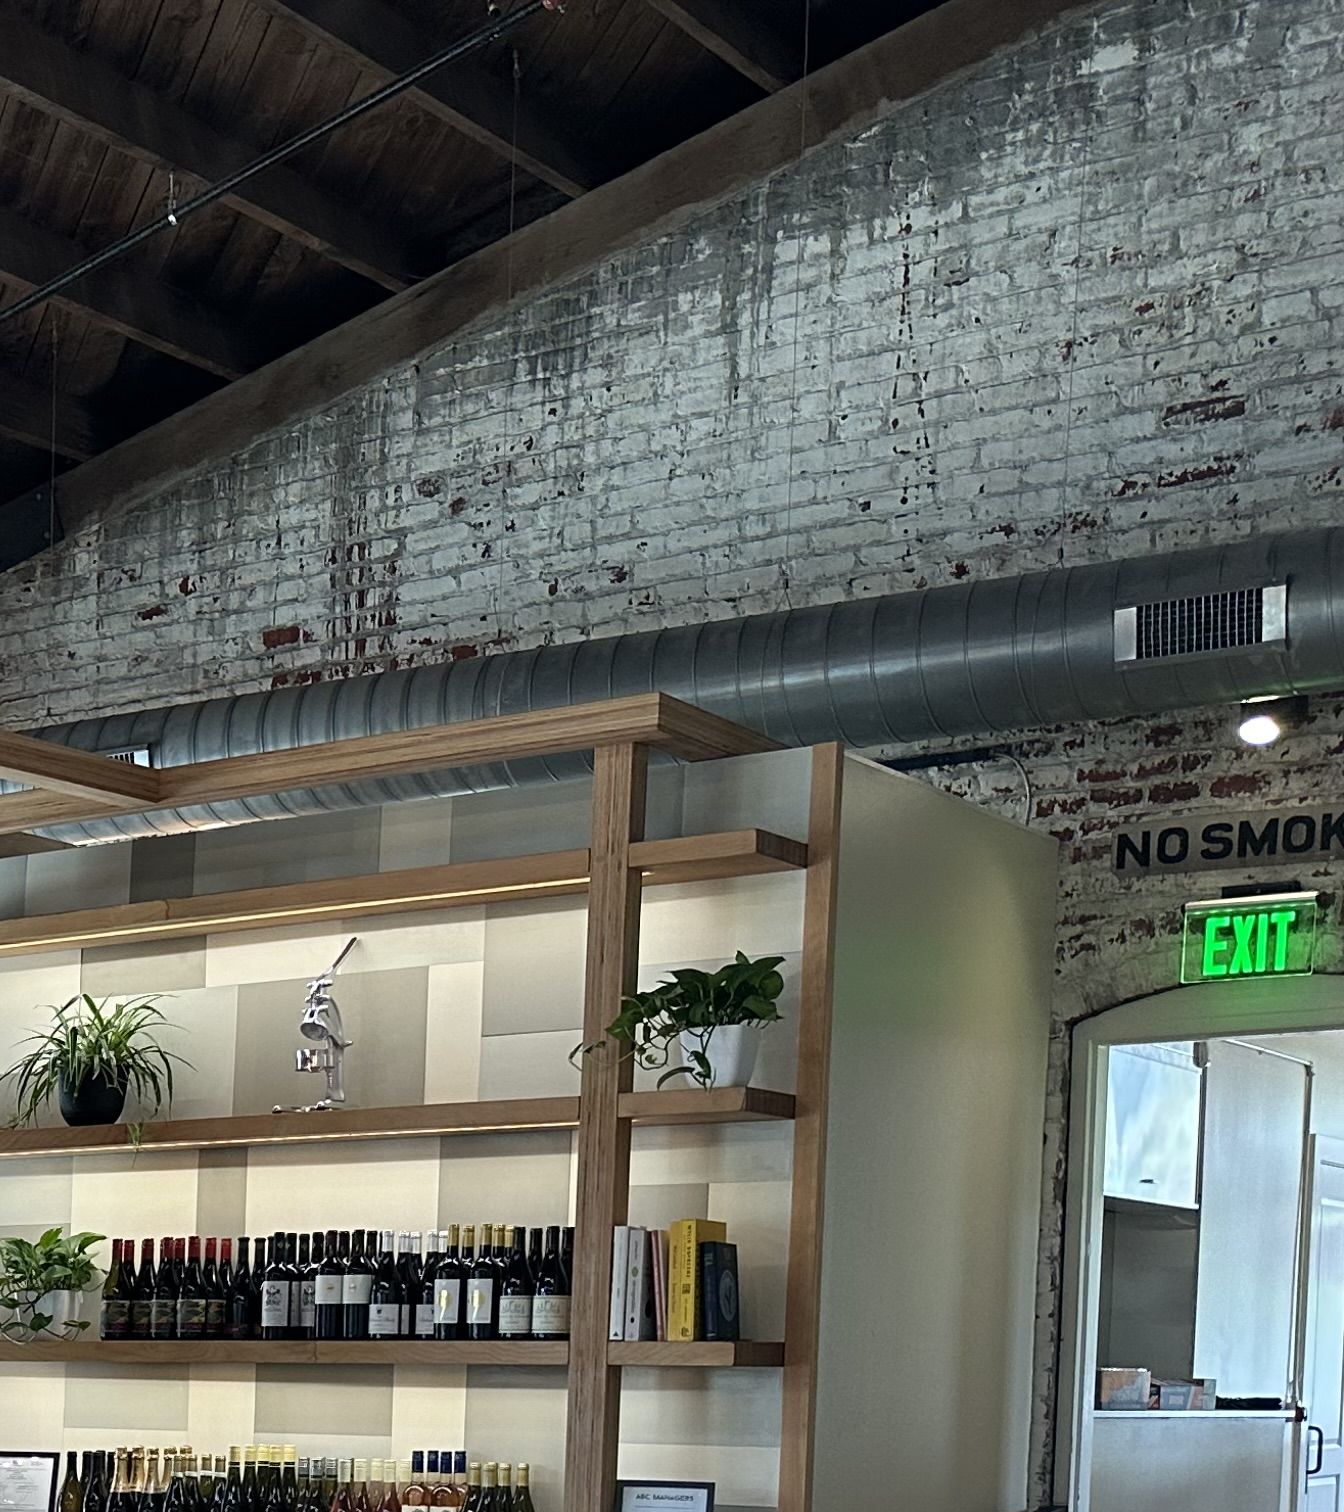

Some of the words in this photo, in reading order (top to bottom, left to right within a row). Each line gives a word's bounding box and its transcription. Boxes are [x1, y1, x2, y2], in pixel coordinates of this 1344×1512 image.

[1115, 827, 1190, 870] NO
[1200, 812, 1344, 860] SMOK
[1202, 911, 1296, 977] EXIT
[635, 1493, 651, 1501] ABC
